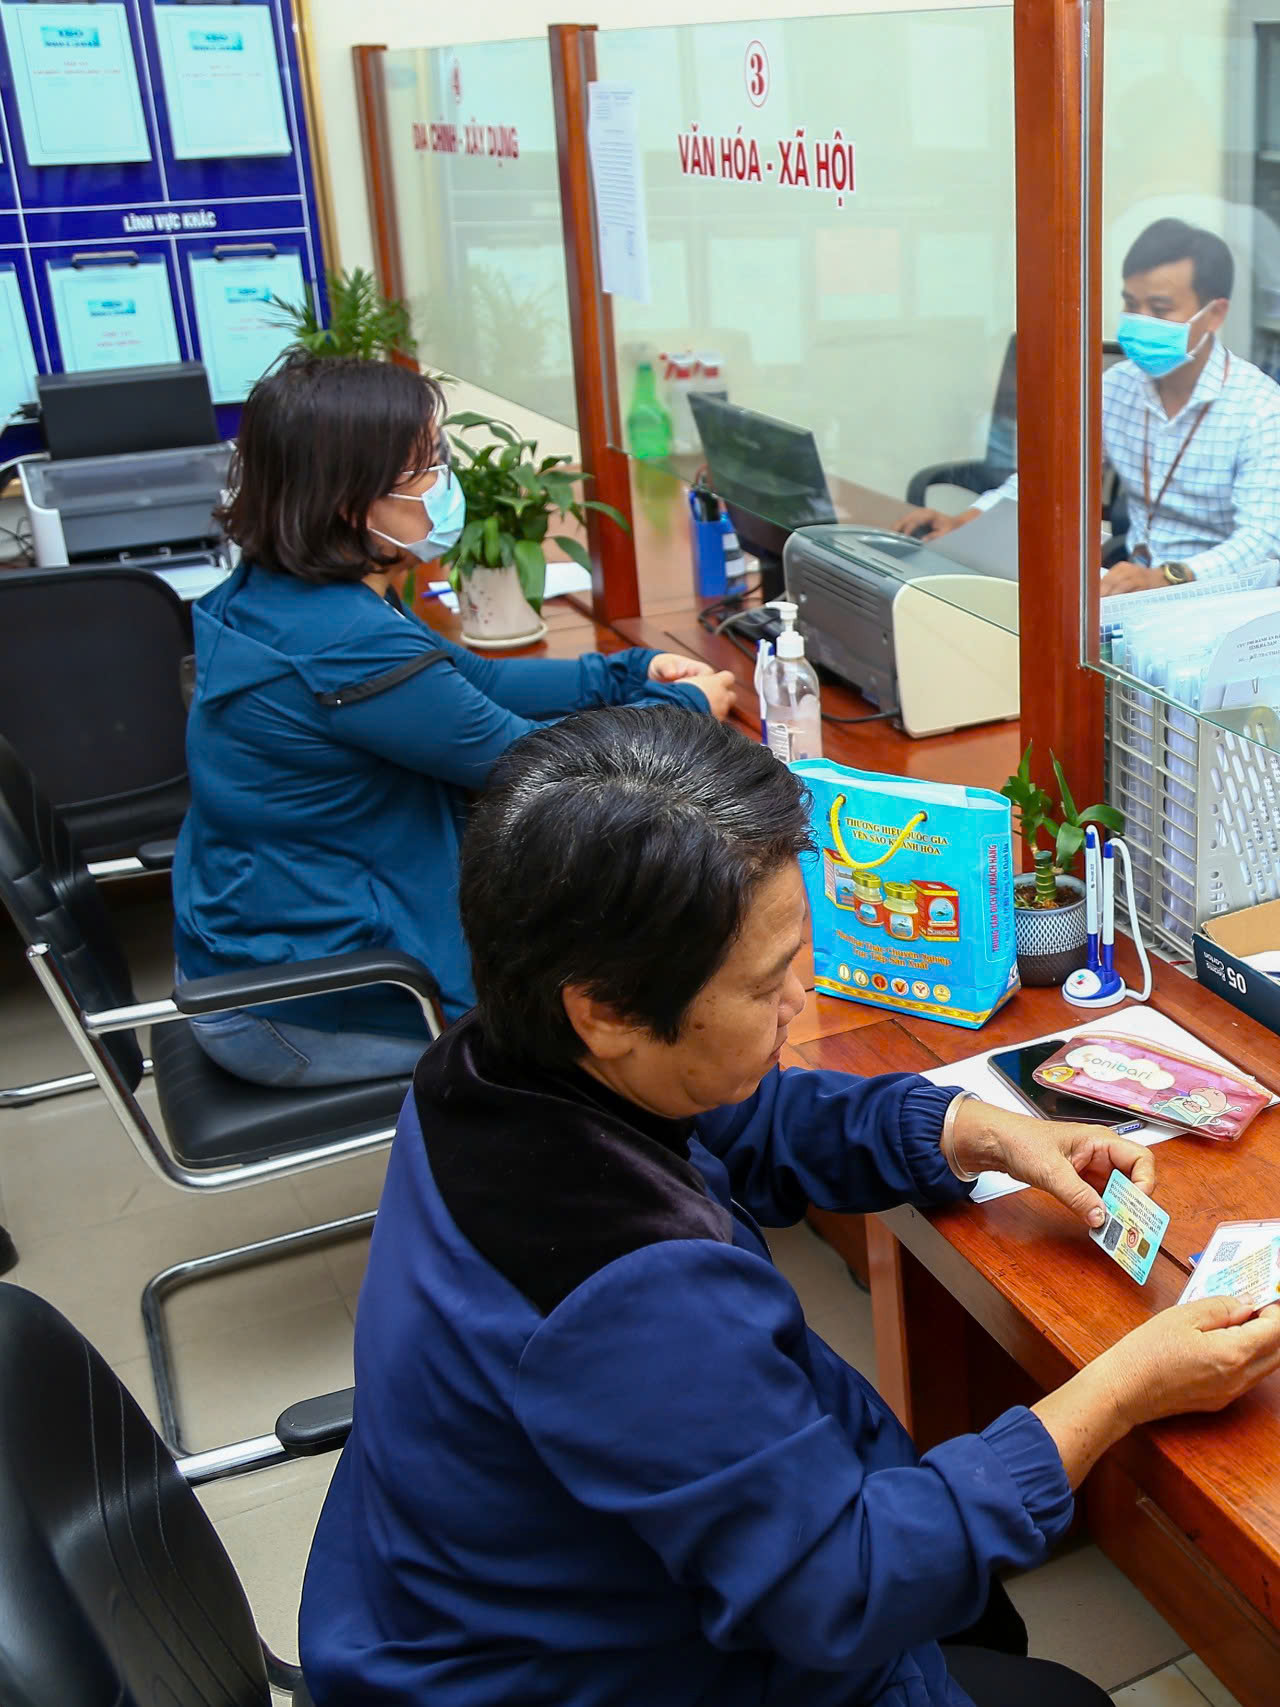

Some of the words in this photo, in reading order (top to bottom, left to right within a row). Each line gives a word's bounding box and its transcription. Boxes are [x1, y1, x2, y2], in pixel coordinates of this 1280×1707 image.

[750, 53, 765, 96] 3
[678, 123, 716, 177] VĂN
[720, 125, 762, 182] HÓA
[778, 129, 810, 187] XÃ
[815, 130, 855, 207] HỘI
[930, 835, 949, 846] GIA
[988, 866, 998, 886] KHÁCH
[1203, 951, 1225, 973] Carton
[1226, 966, 1247, 994] 05
